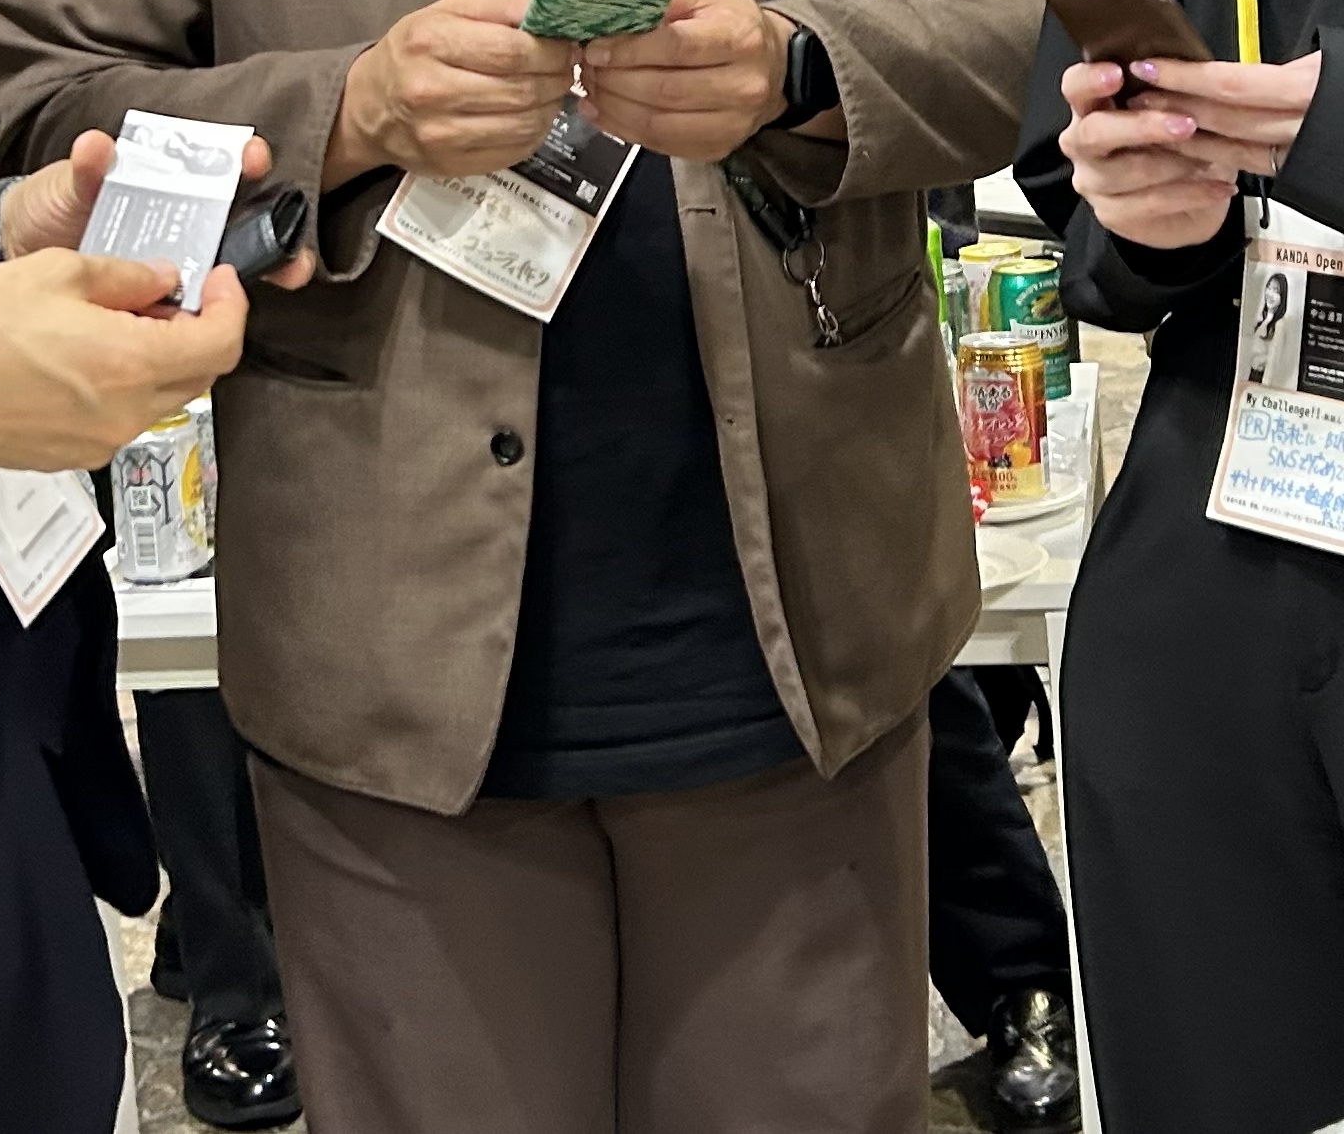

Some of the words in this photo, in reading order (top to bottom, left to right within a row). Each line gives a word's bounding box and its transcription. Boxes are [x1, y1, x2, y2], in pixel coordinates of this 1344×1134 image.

[1276, 247, 1309, 266] KANDA
[1316, 253, 1343, 271] Open
[1246, 393, 1258, 407] My
[1244, 416, 1264, 436] PR
